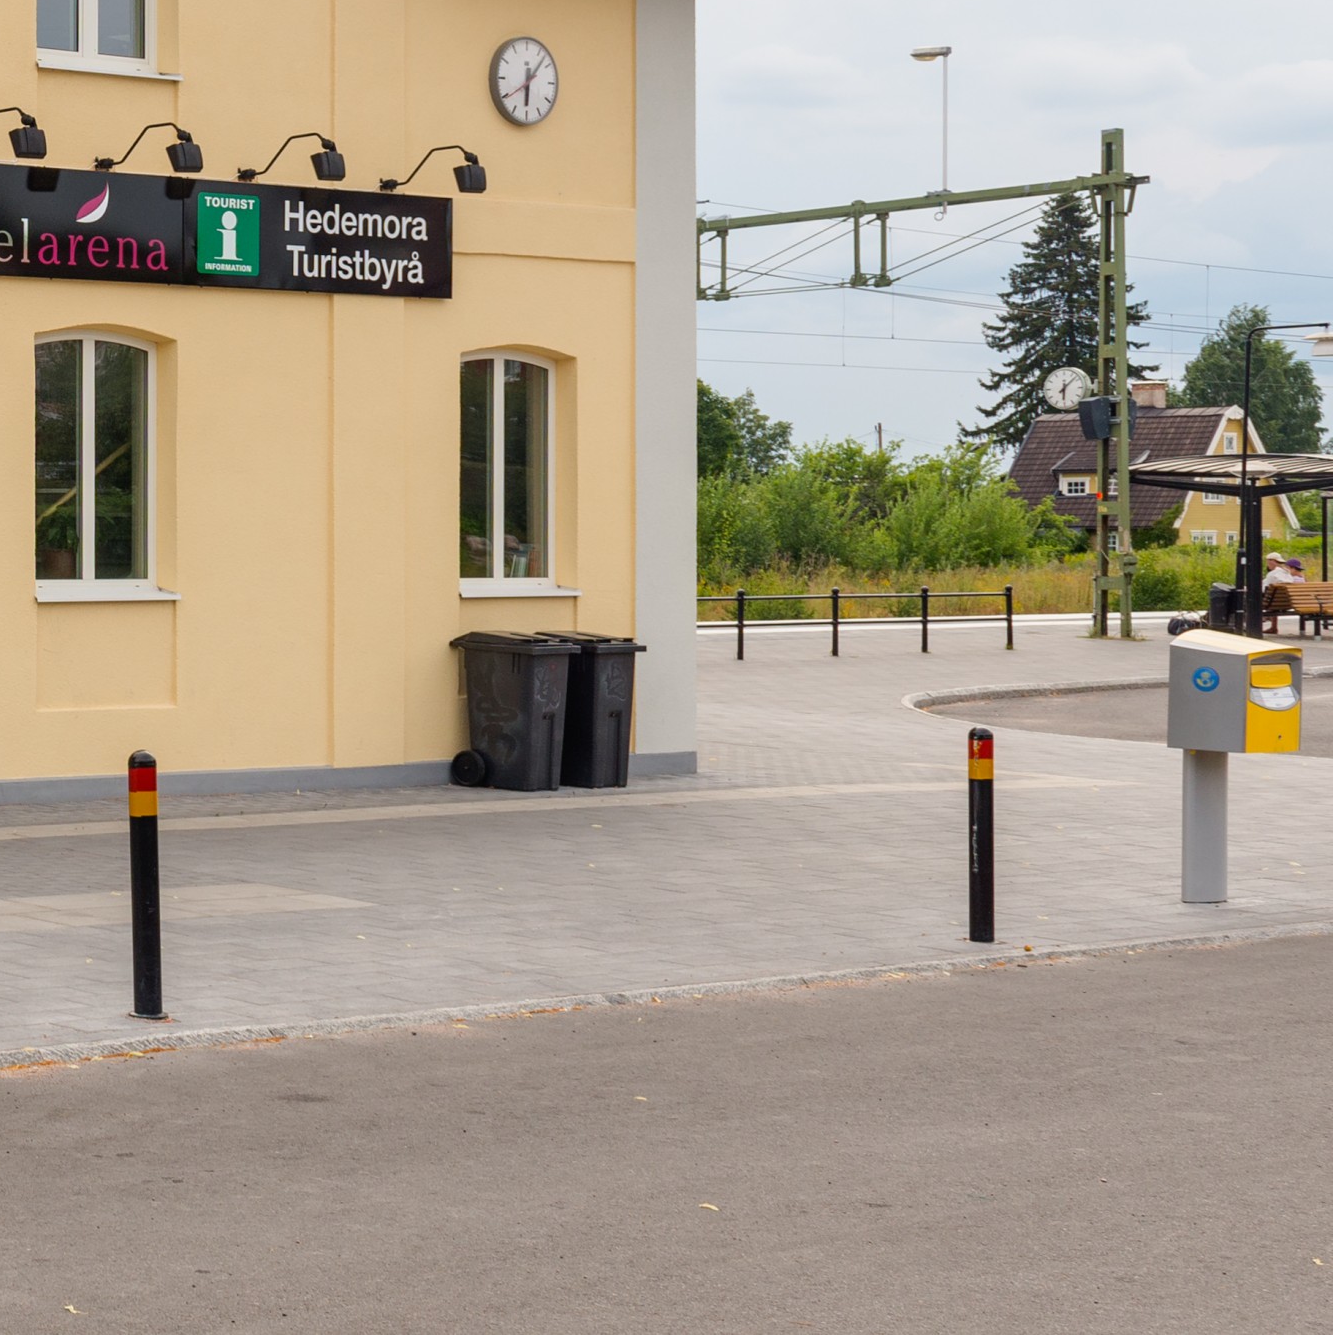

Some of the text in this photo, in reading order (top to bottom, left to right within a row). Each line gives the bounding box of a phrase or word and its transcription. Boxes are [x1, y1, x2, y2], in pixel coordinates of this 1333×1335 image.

[204, 196, 255, 210] TOURIST
[284, 200, 428, 241] Hedemora
[205, 262, 252, 273] INFORMATION
[286, 245, 424, 289] Turistbyrå
